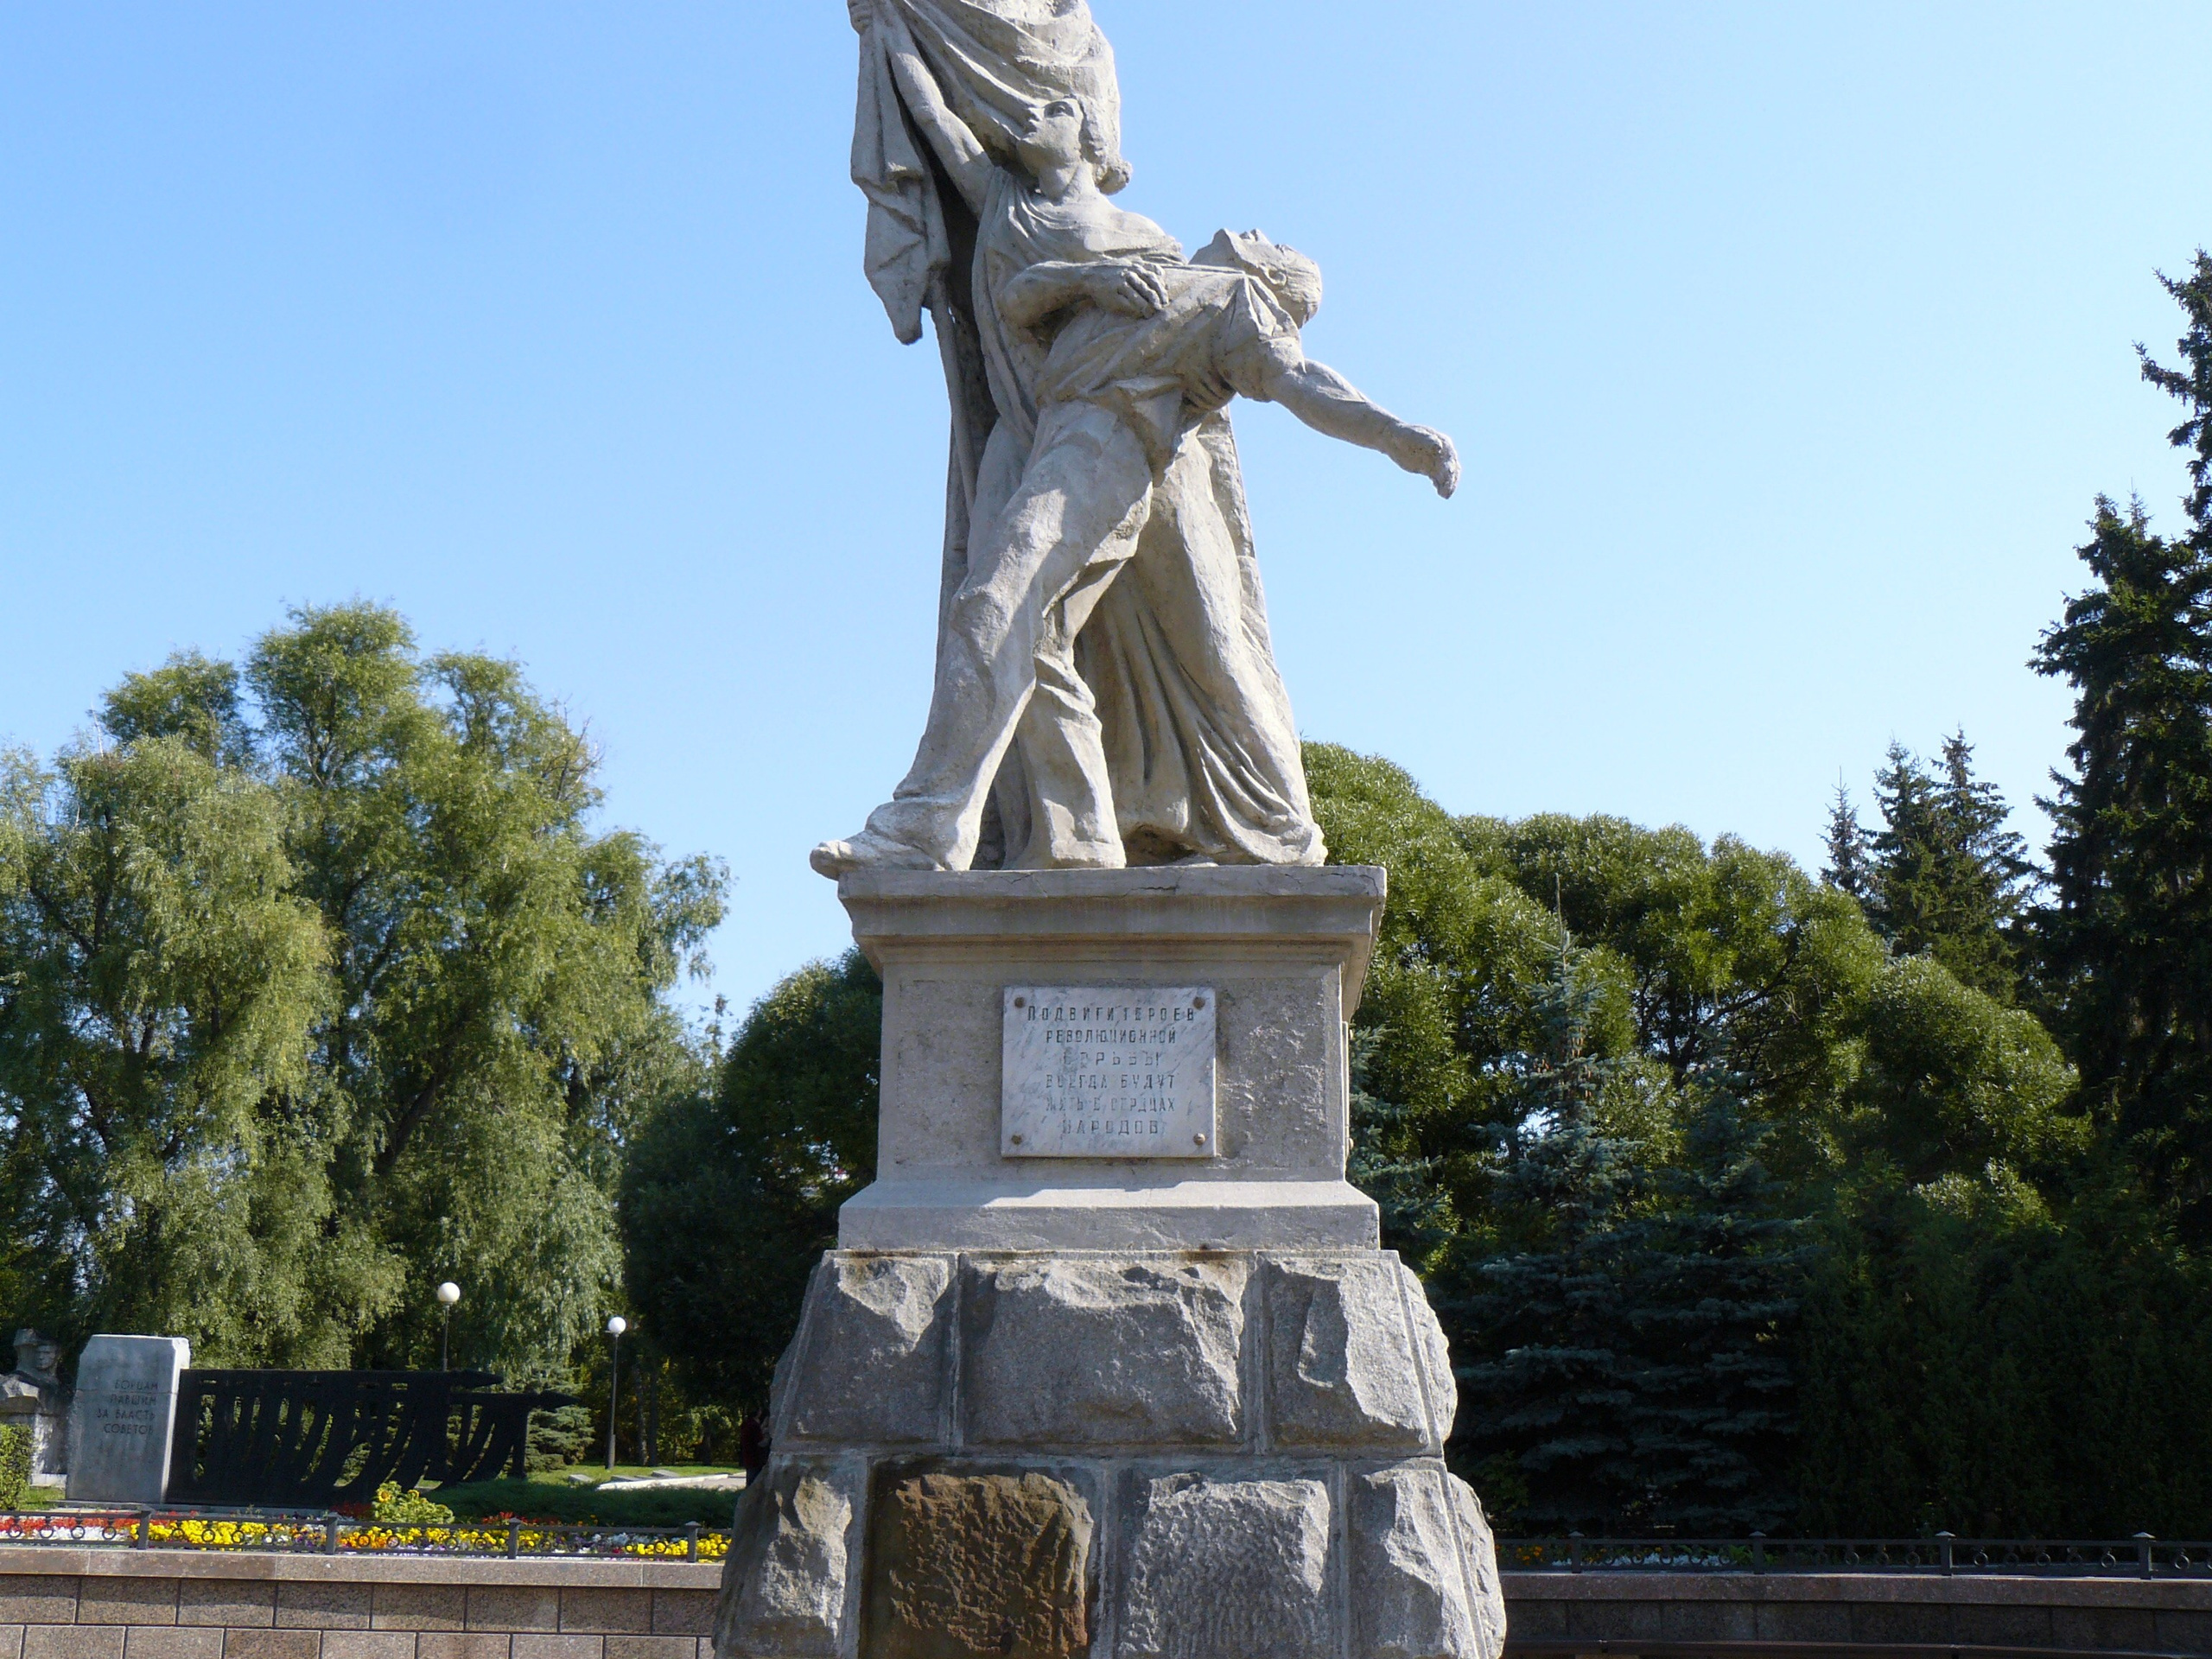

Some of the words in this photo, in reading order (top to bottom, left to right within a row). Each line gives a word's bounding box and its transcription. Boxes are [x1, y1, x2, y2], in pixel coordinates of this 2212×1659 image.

[1123, 1007, 1194, 1021] ГЕРОЕВ
[1046, 1027, 1176, 1044] РЕВОЛЮЦИОННОЙ
[1046, 1074, 1108, 1090] ВСЕГДА
[1121, 1074, 1175, 1090] БУДУТ
[1110, 1097, 1175, 1112] СЕРДЦАХ
[1062, 1119, 1159, 1135] НАРОДОВ
